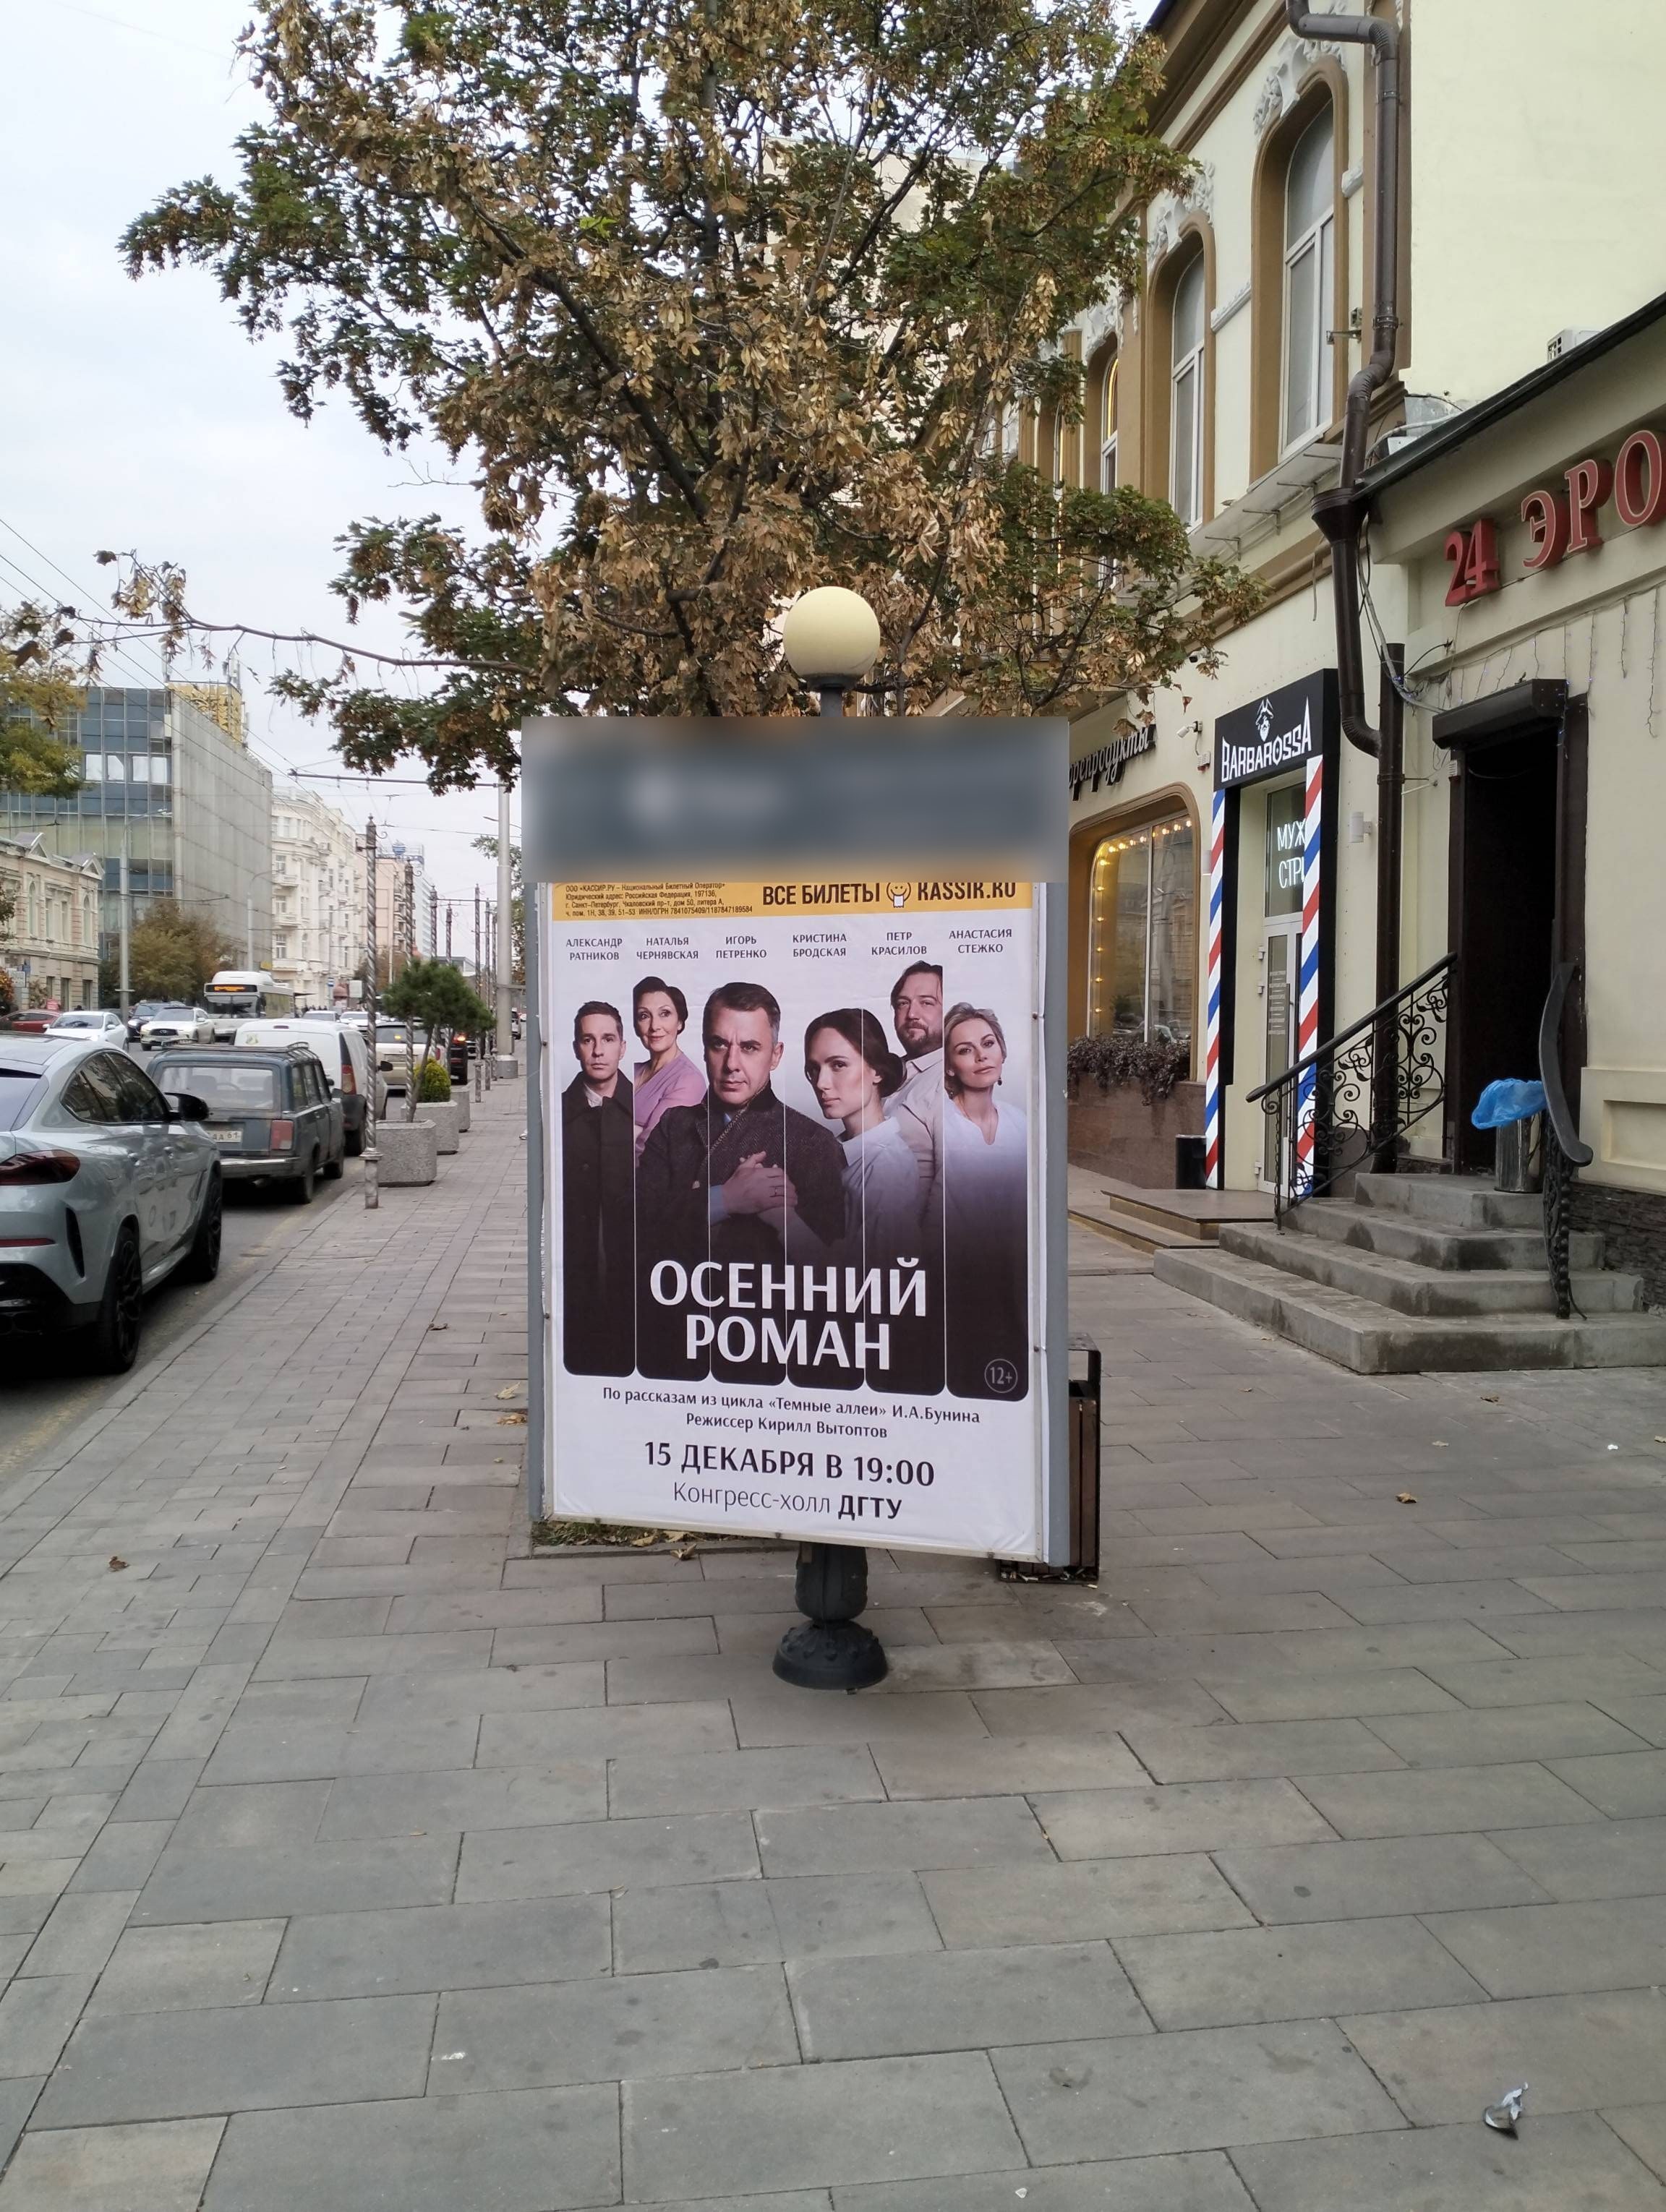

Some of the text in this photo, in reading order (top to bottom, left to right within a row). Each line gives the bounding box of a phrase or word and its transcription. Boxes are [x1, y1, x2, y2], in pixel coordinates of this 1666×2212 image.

[1445, 429, 1663, 607] 24 ЭРО
[1221, 696, 1312, 783] BARBAROSSA
[622, 883, 663, 892] Национальный
[763, 883, 880, 905] ВСЕ БИЛЕТЫ
[725, 935, 757, 945] ИГОРЬ
[793, 933, 847, 943] КРИСТИНА
[887, 931, 913, 941] ПЕТР
[949, 929, 1012, 940] АНАСТАСИЯ
[565, 938, 623, 948] АЛЕКСАНДР
[646, 937, 689, 946] НАТАЛЬЯ
[716, 949, 767, 959] ПЕТРЕНКО
[793, 948, 847, 959] БРОДСКАЯ
[871, 946, 928, 956] КРАСИЛОВ
[957, 943, 1004, 954] СТЕЖКО
[570, 951, 620, 961] РАТНИКОВ
[636, 951, 699, 960] ЧЕРНЯВСКАЯ
[650, 1257, 926, 1316] ОСЕННИЙ
[686, 1314, 890, 1370] РОМАН
[990, 1366, 1013, 1384] 12+
[602, 1387, 981, 1426] По рассказам из цикла «Темные аллеи» И.А.Бунина
[686, 1412, 888, 1439] Режиссер Кирилл Вытоптов
[644, 1441, 935, 1486] 15 ДЕКАБРЯ В 19:00
[673, 1482, 902, 1520] Конгресс-холл ДГТУ
